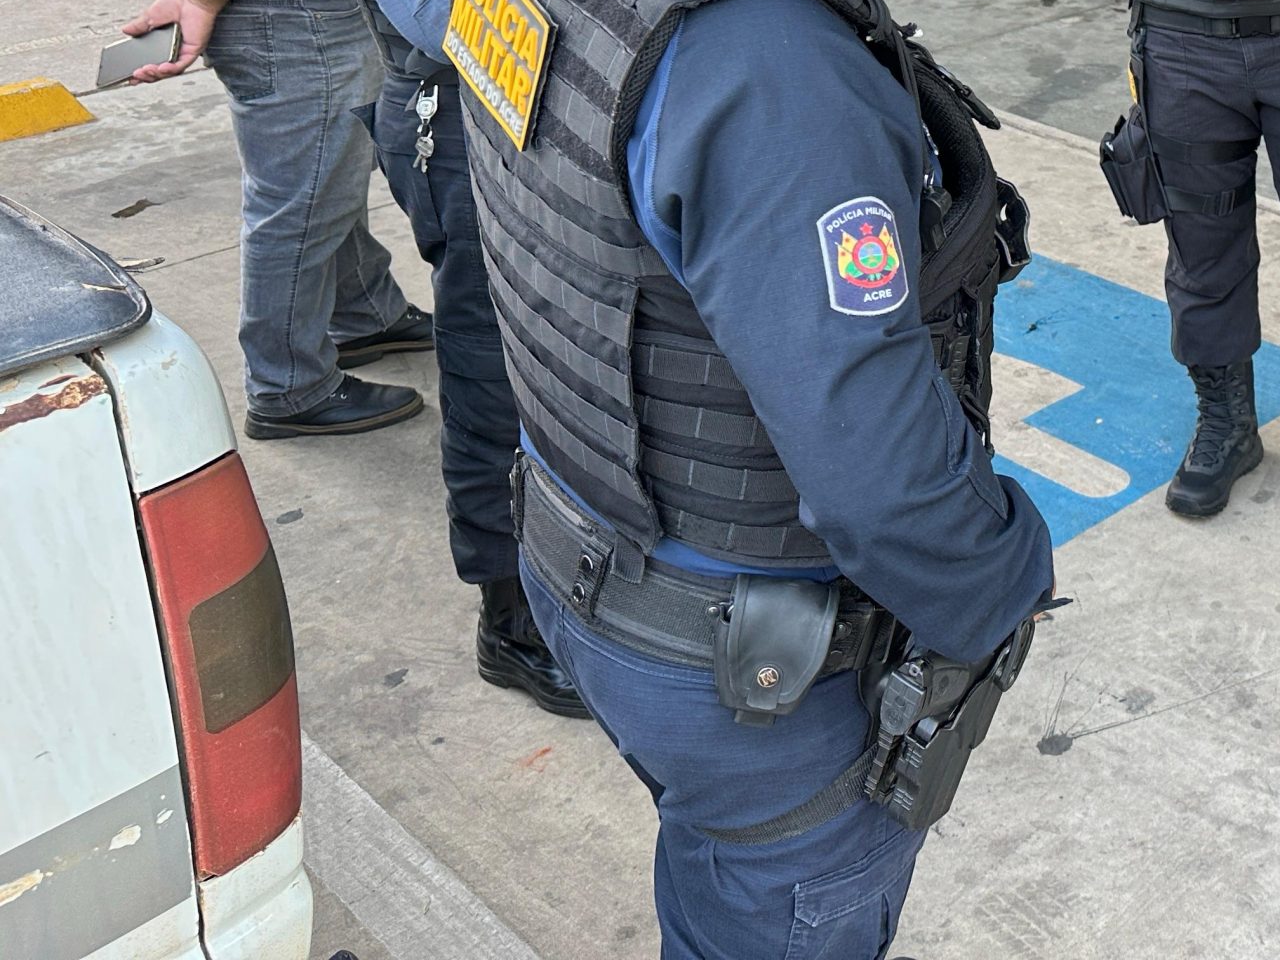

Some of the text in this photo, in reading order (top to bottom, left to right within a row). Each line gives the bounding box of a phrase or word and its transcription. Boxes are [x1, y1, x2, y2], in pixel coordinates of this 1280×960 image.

[457, 45, 486, 92] ESTADO
[485, 83, 500, 107] DO
[498, 100, 524, 137] ACRE
[826, 206, 892, 233] POLÍCIA MILITAR
[863, 288, 892, 302] ACRE
